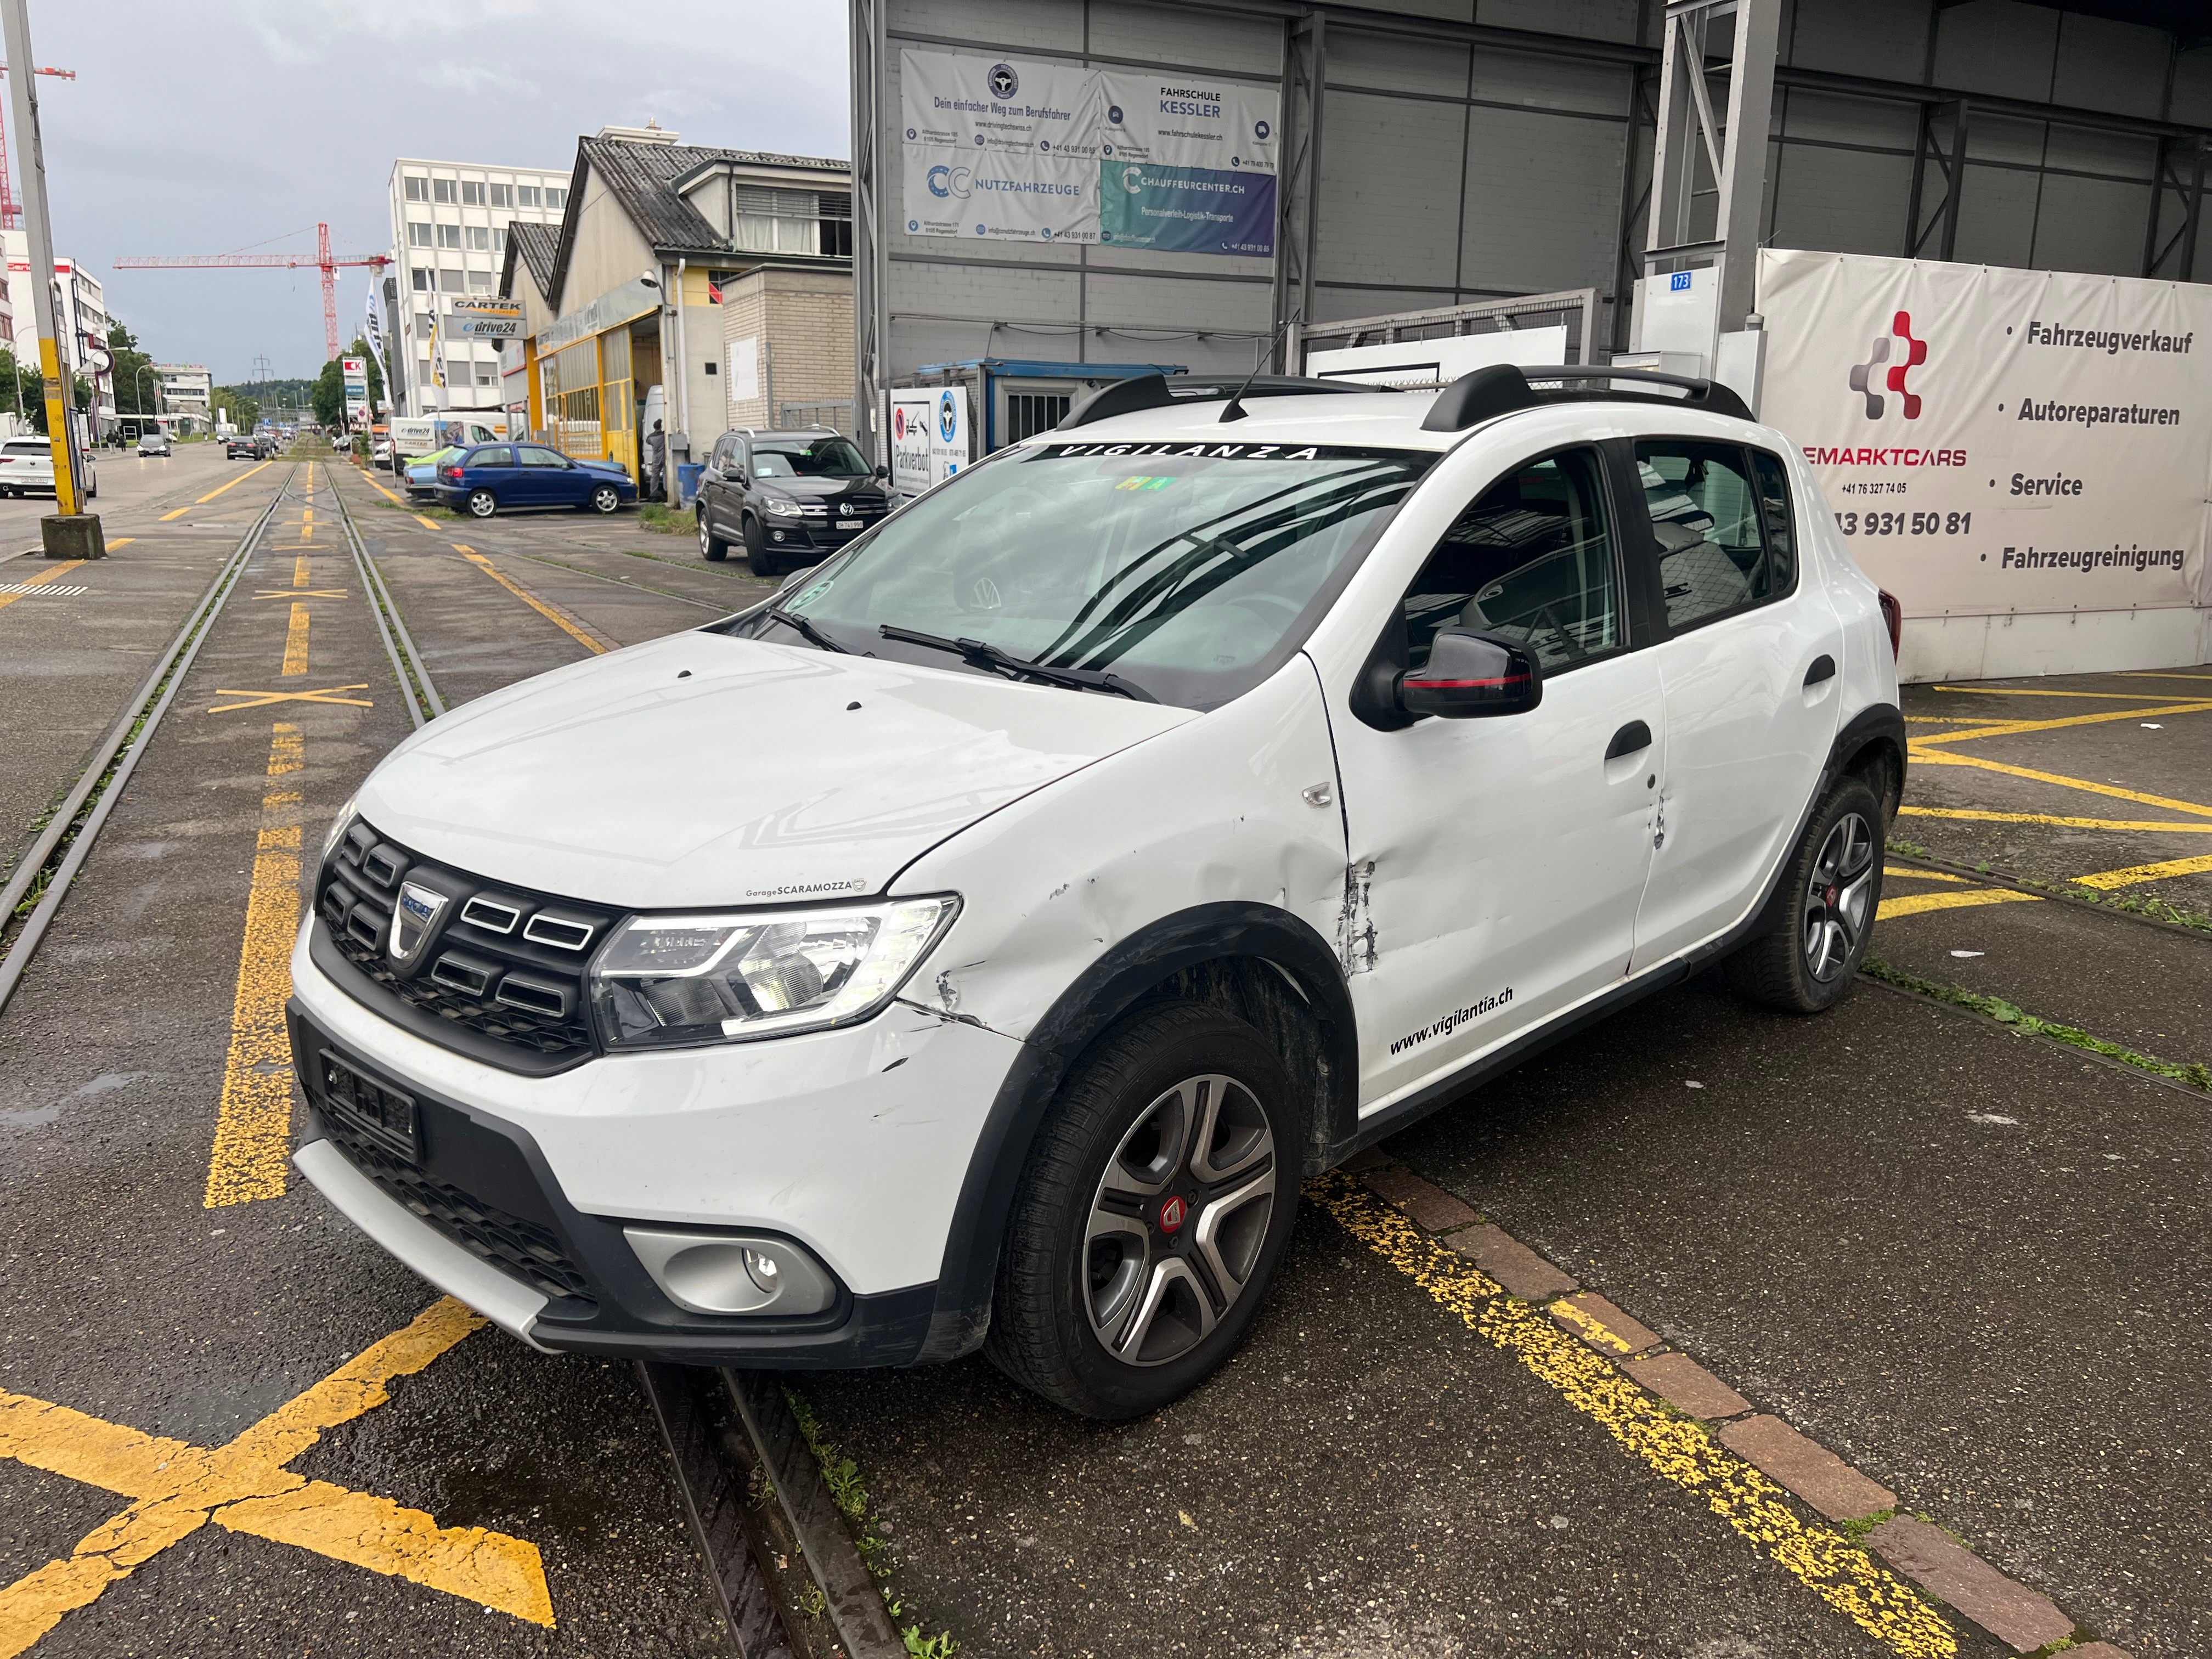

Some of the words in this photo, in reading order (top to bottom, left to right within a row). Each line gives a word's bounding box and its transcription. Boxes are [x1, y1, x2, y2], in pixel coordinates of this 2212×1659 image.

[1160, 87, 1221, 101] FAHRSCHULE
[934, 97, 951, 109] Dein
[953, 99, 988, 112] einfacher
[991, 102, 1007, 117] Weg
[1008, 107, 1024, 116] zum
[1026, 106, 1071, 121] Berufsfahrer
[1160, 100, 1221, 118] KESSLER
[975, 178, 1080, 196] NUTZFAHRZEUGE
[1141, 177, 1245, 194] CHAUFFEURCENTER.CH
[1673, 275, 1688, 289] 173
[455, 301, 521, 310] CARTEK
[2028, 321, 2193, 354] Fahrzeugverkauf
[2018, 398, 2180, 428] Autoreparaturen
[896, 444, 928, 472] Parkverbot
[1059, 444, 1317, 460] VIGILANZA
[1842, 483, 1855, 494] +41
[1858, 483, 1867, 494] 76
[1869, 483, 1883, 494] 327
[1886, 483, 1895, 494] 74
[1897, 483, 1906, 494] 05
[2010, 472, 2083, 495] Service
[1864, 512, 1905, 535] 931
[1910, 512, 1940, 535] 50
[1945, 512, 1971, 535] 81
[2002, 544, 2184, 573] Fahrzeugreinigung
[777, 881, 853, 895] SCARAMOZZA
[1390, 986, 1513, 1055] www.vigilantia.ch
